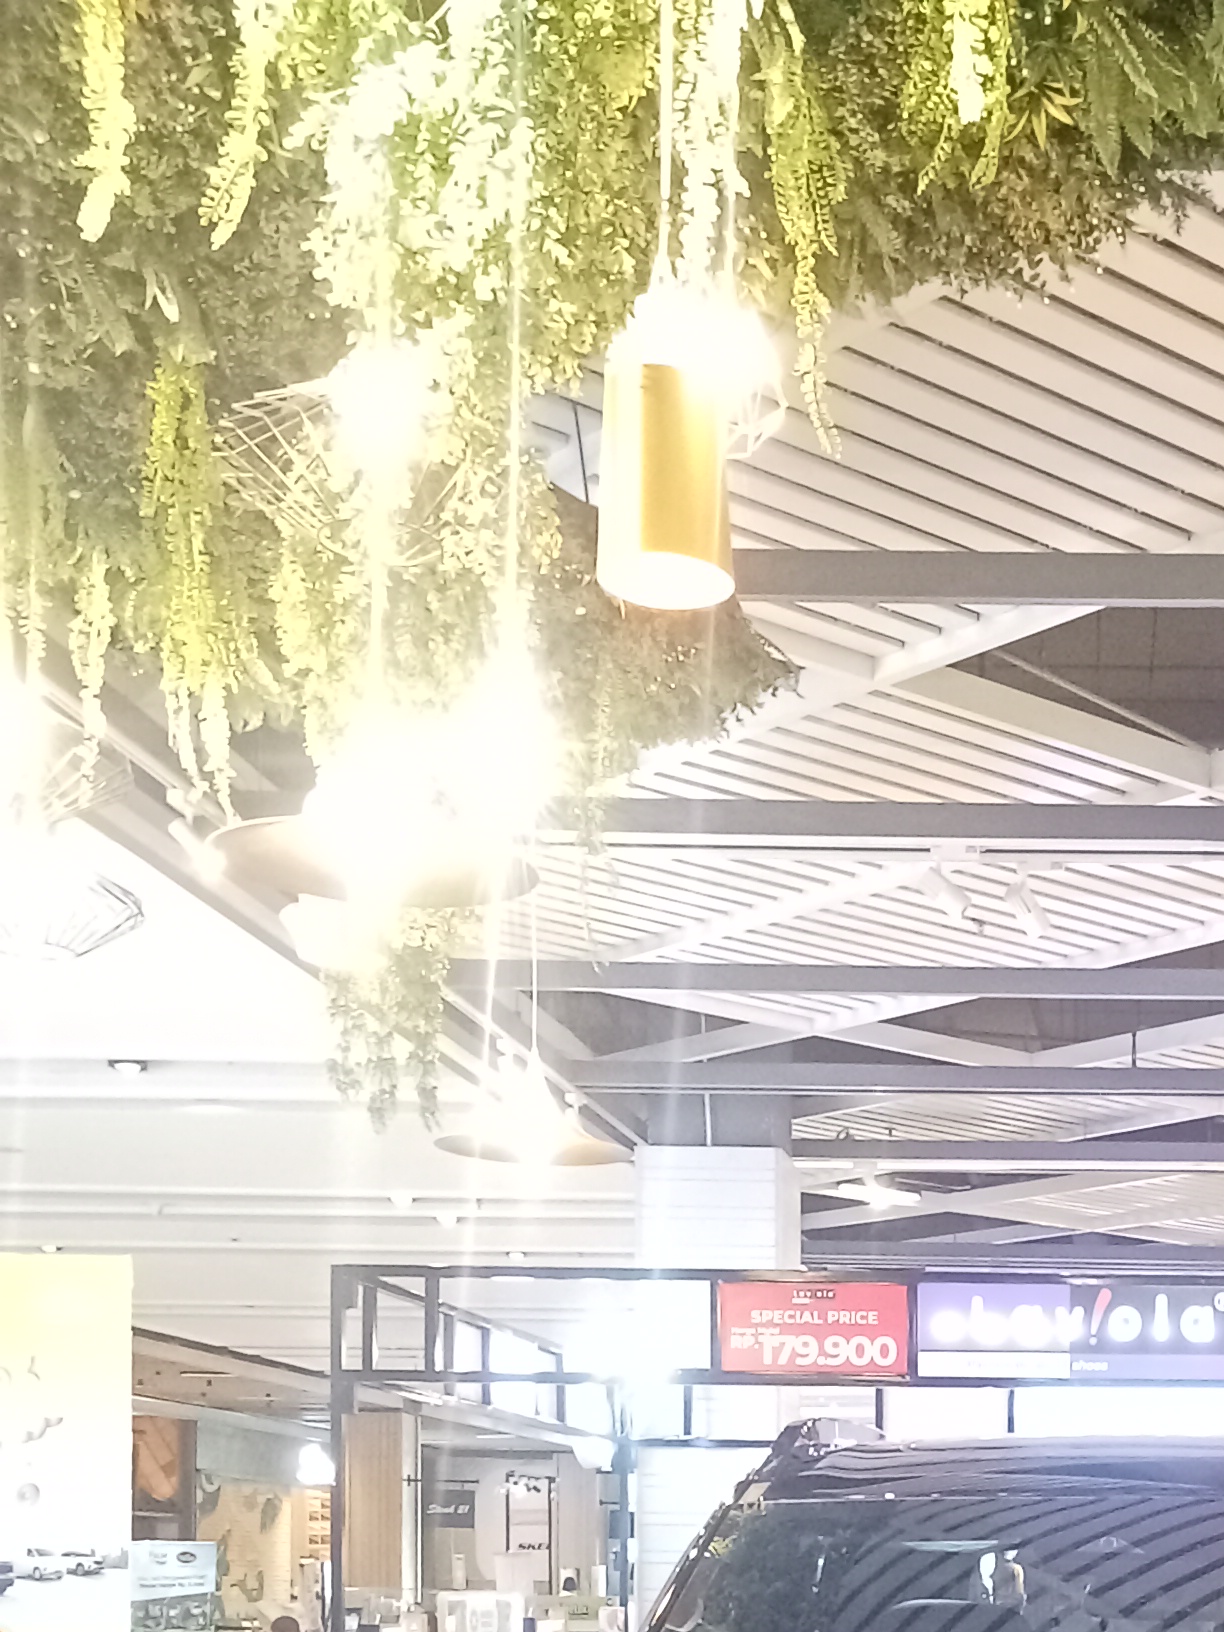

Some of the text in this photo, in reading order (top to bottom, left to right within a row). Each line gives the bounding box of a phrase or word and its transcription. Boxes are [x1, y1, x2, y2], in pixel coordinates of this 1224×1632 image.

[751, 1310, 879, 1325] SPECIAL PRICE
[758, 1335, 898, 1367] 179.900
